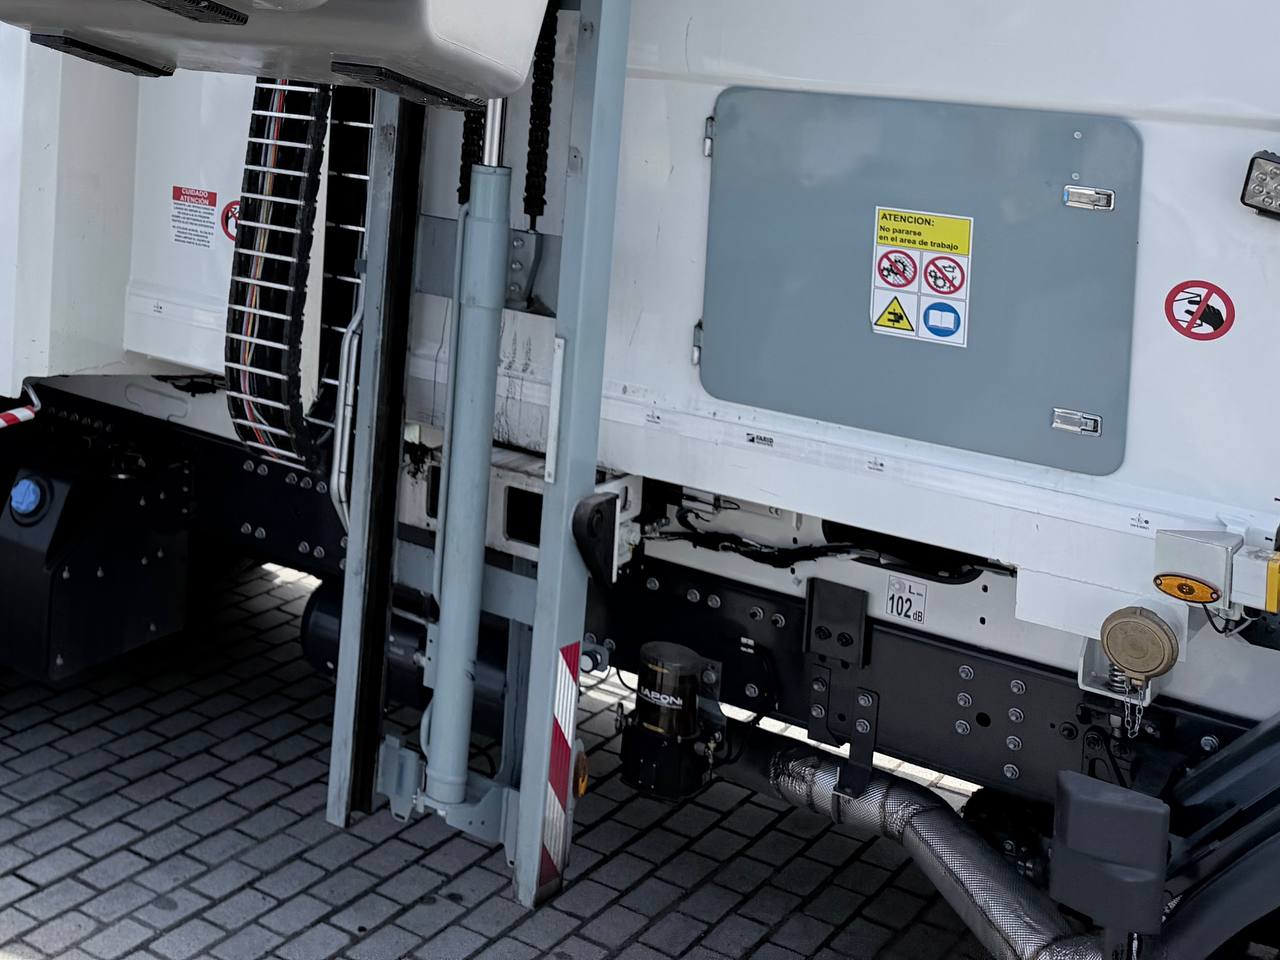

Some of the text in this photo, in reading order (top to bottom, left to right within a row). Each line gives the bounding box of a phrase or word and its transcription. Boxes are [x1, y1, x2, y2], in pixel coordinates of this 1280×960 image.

[181, 187, 208, 198] CUIDADO
[180, 194, 209, 205] ATENCIÓN
[881, 213, 934, 226] ATENCION:
[892, 227, 922, 236] pararse
[930, 241, 958, 251] trabajo
[889, 593, 922, 622] 102 dB
